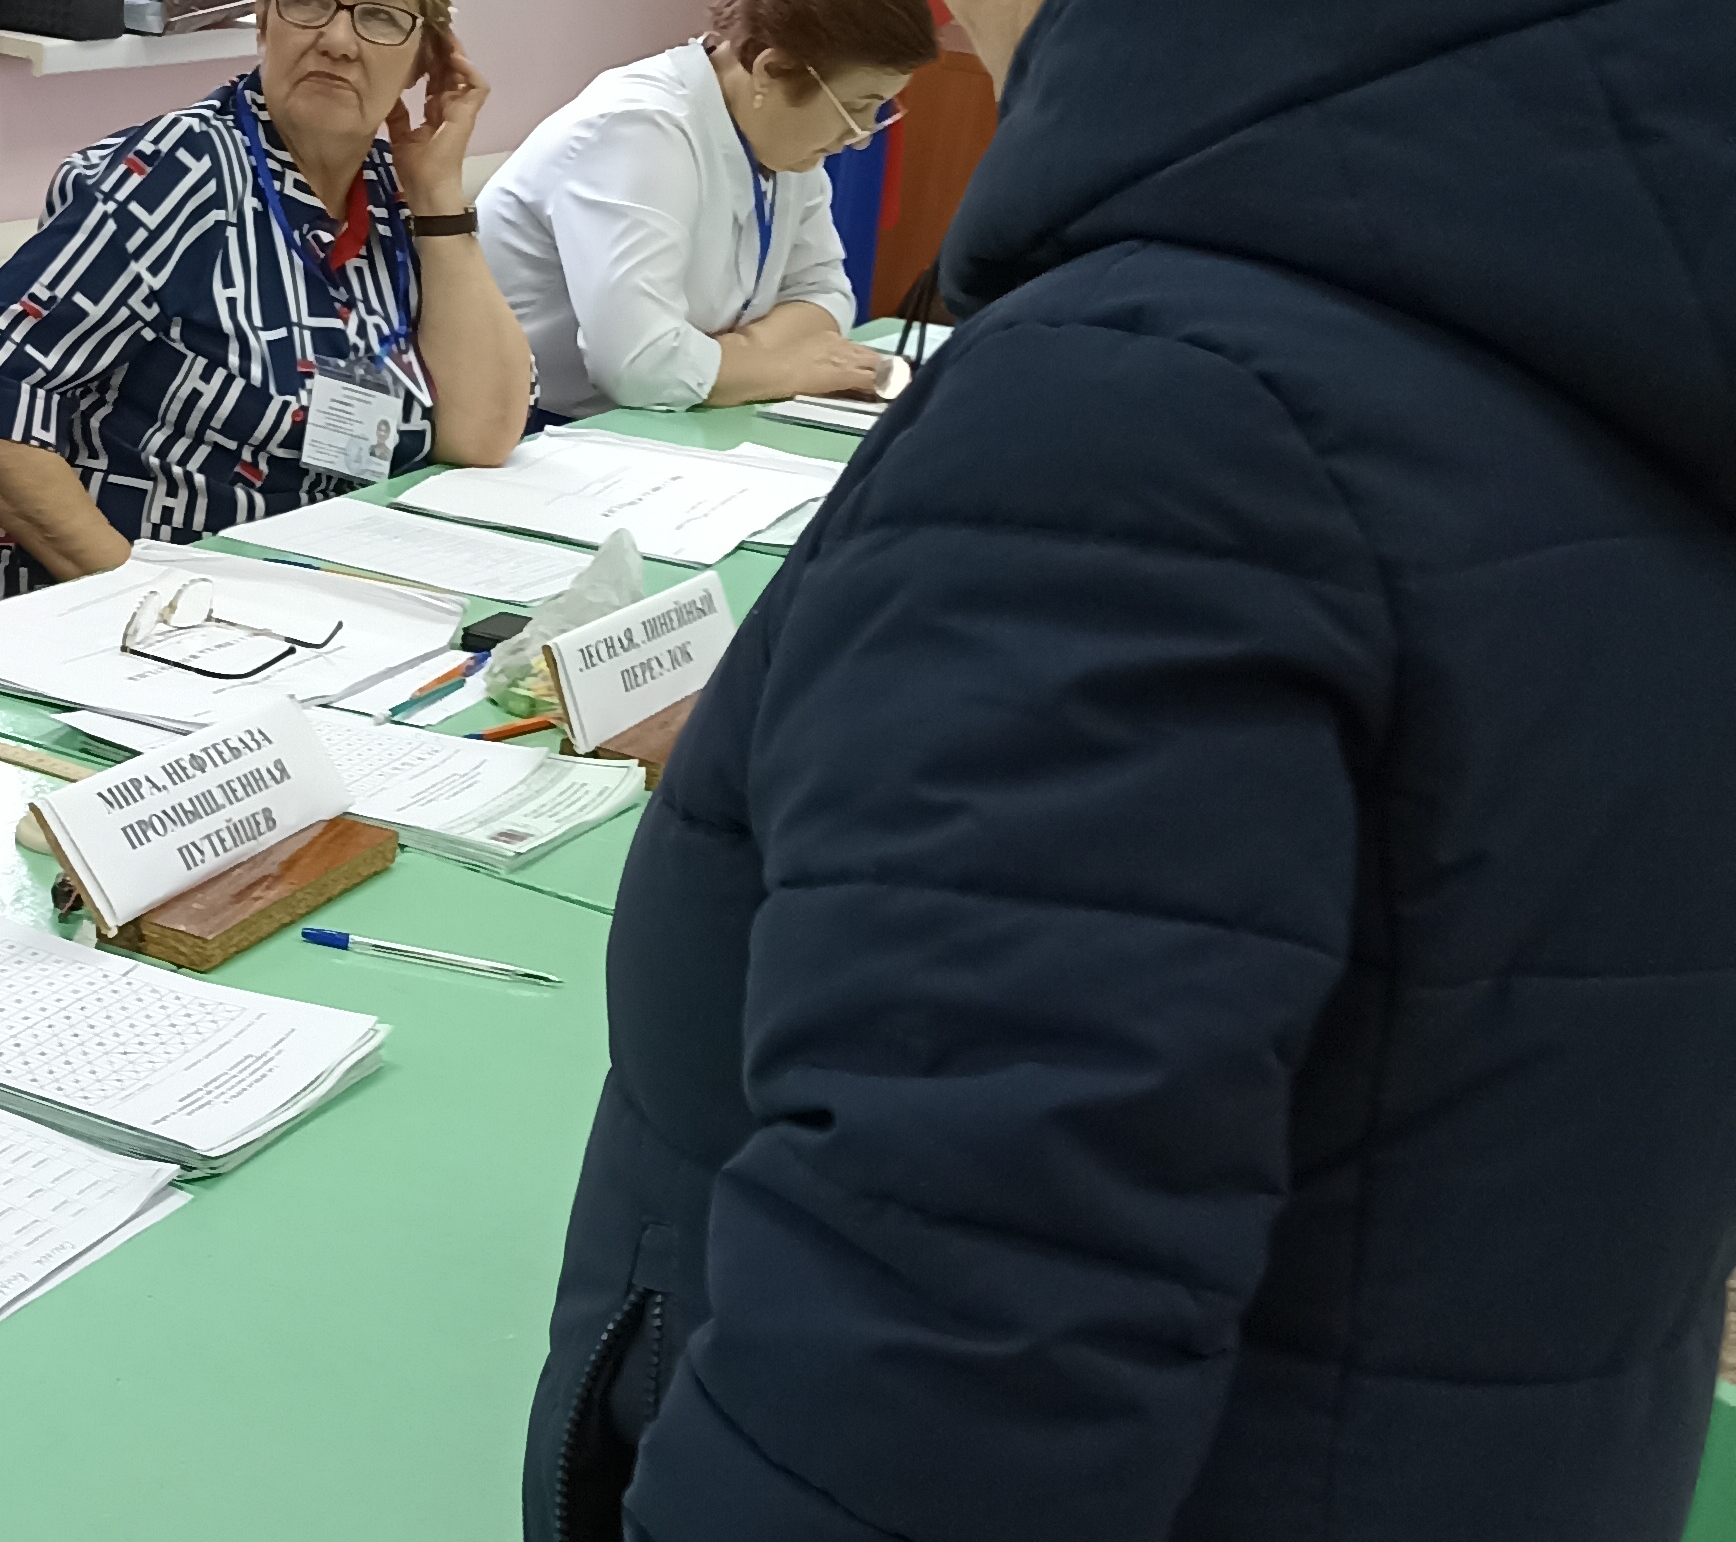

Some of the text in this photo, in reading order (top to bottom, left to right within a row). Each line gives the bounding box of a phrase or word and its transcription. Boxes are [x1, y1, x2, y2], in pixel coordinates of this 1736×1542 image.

[96, 727, 275, 814] МИРА, НЕФТЕБАЗА
[120, 758, 292, 850] ПРОМЫШЛЕННАЯ
[177, 806, 278, 871] ПУТЕЙЦЕВ
